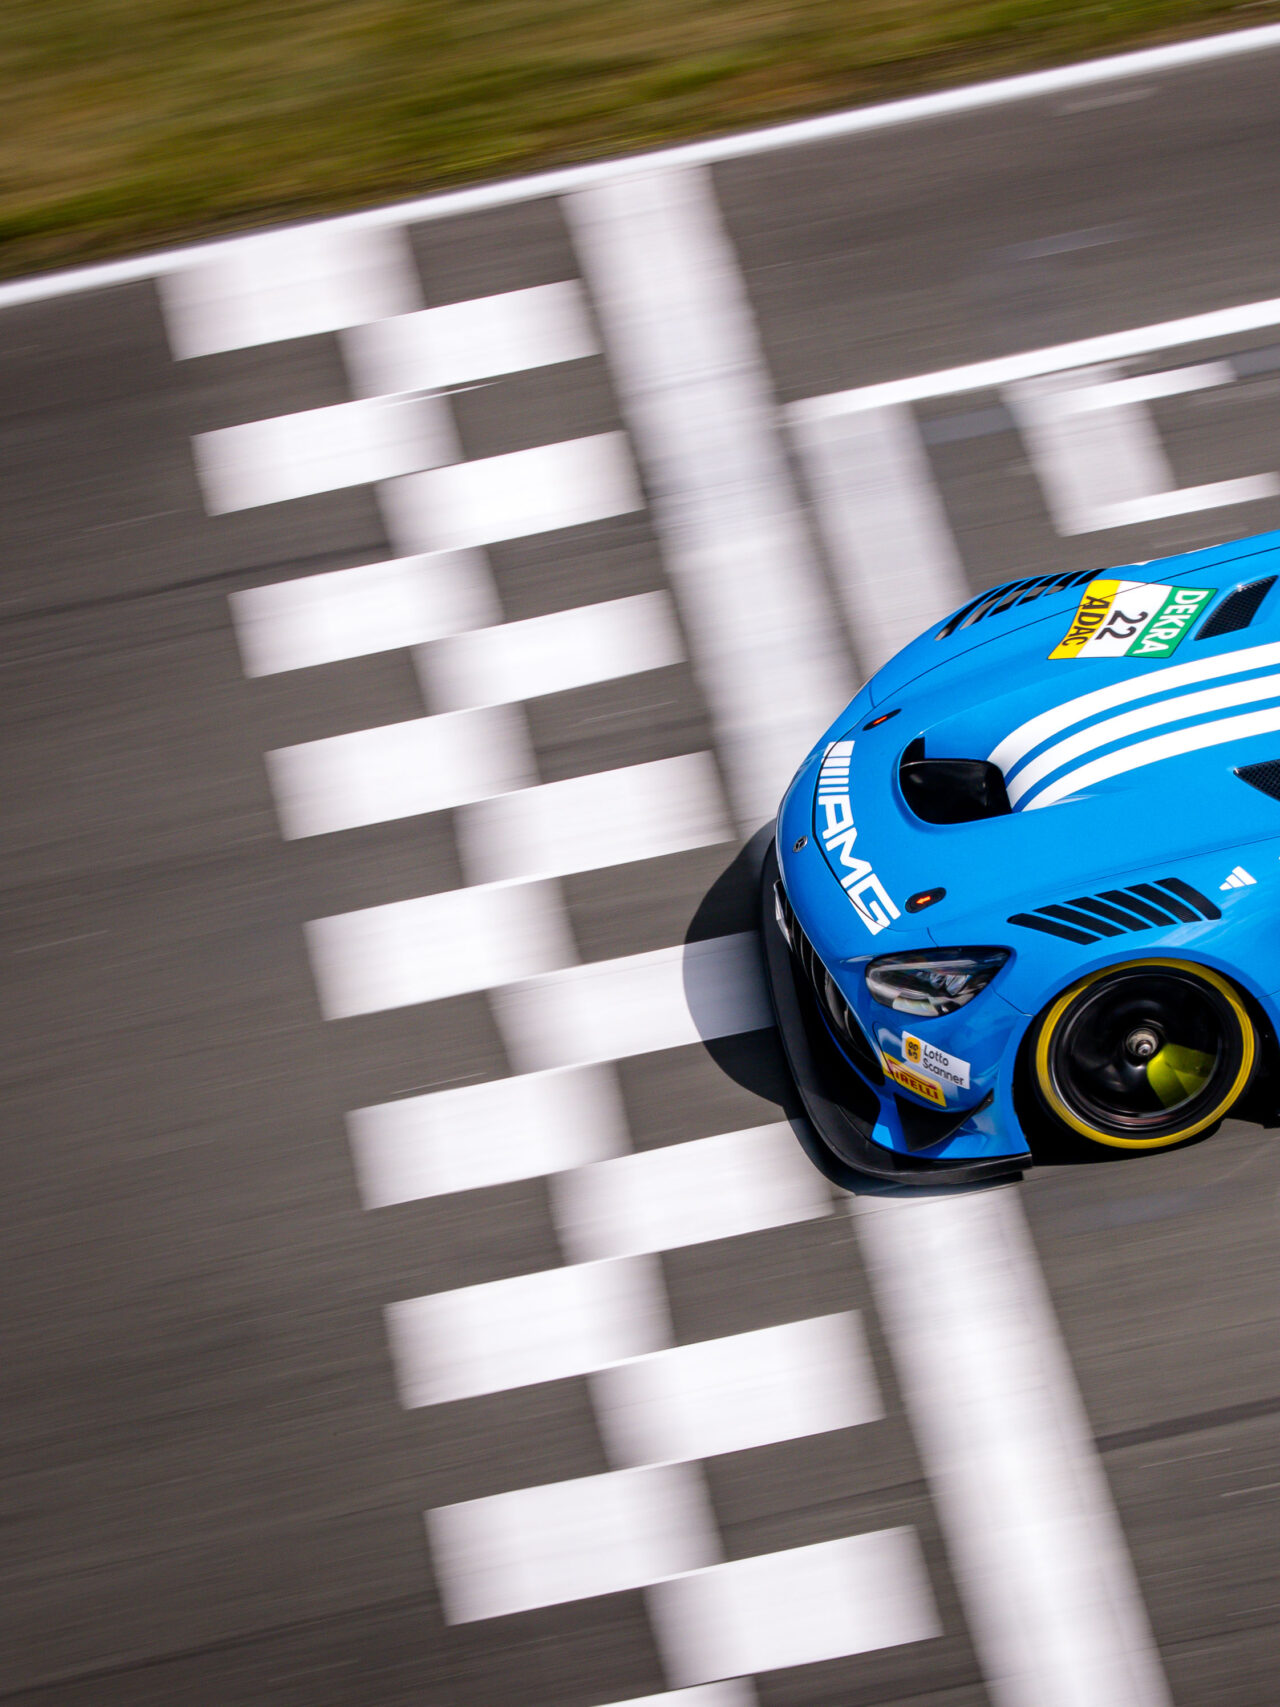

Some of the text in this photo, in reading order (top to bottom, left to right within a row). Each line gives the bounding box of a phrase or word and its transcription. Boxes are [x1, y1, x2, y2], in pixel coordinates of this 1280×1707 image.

[1062, 596, 1110, 646] ADAC
[1094, 610, 1149, 640] 22
[1132, 589, 1209, 654] DEKRA
[819, 795, 901, 936] AMG
[923, 1045, 949, 1067] Lotto
[923, 1058, 965, 1085] Scanner
